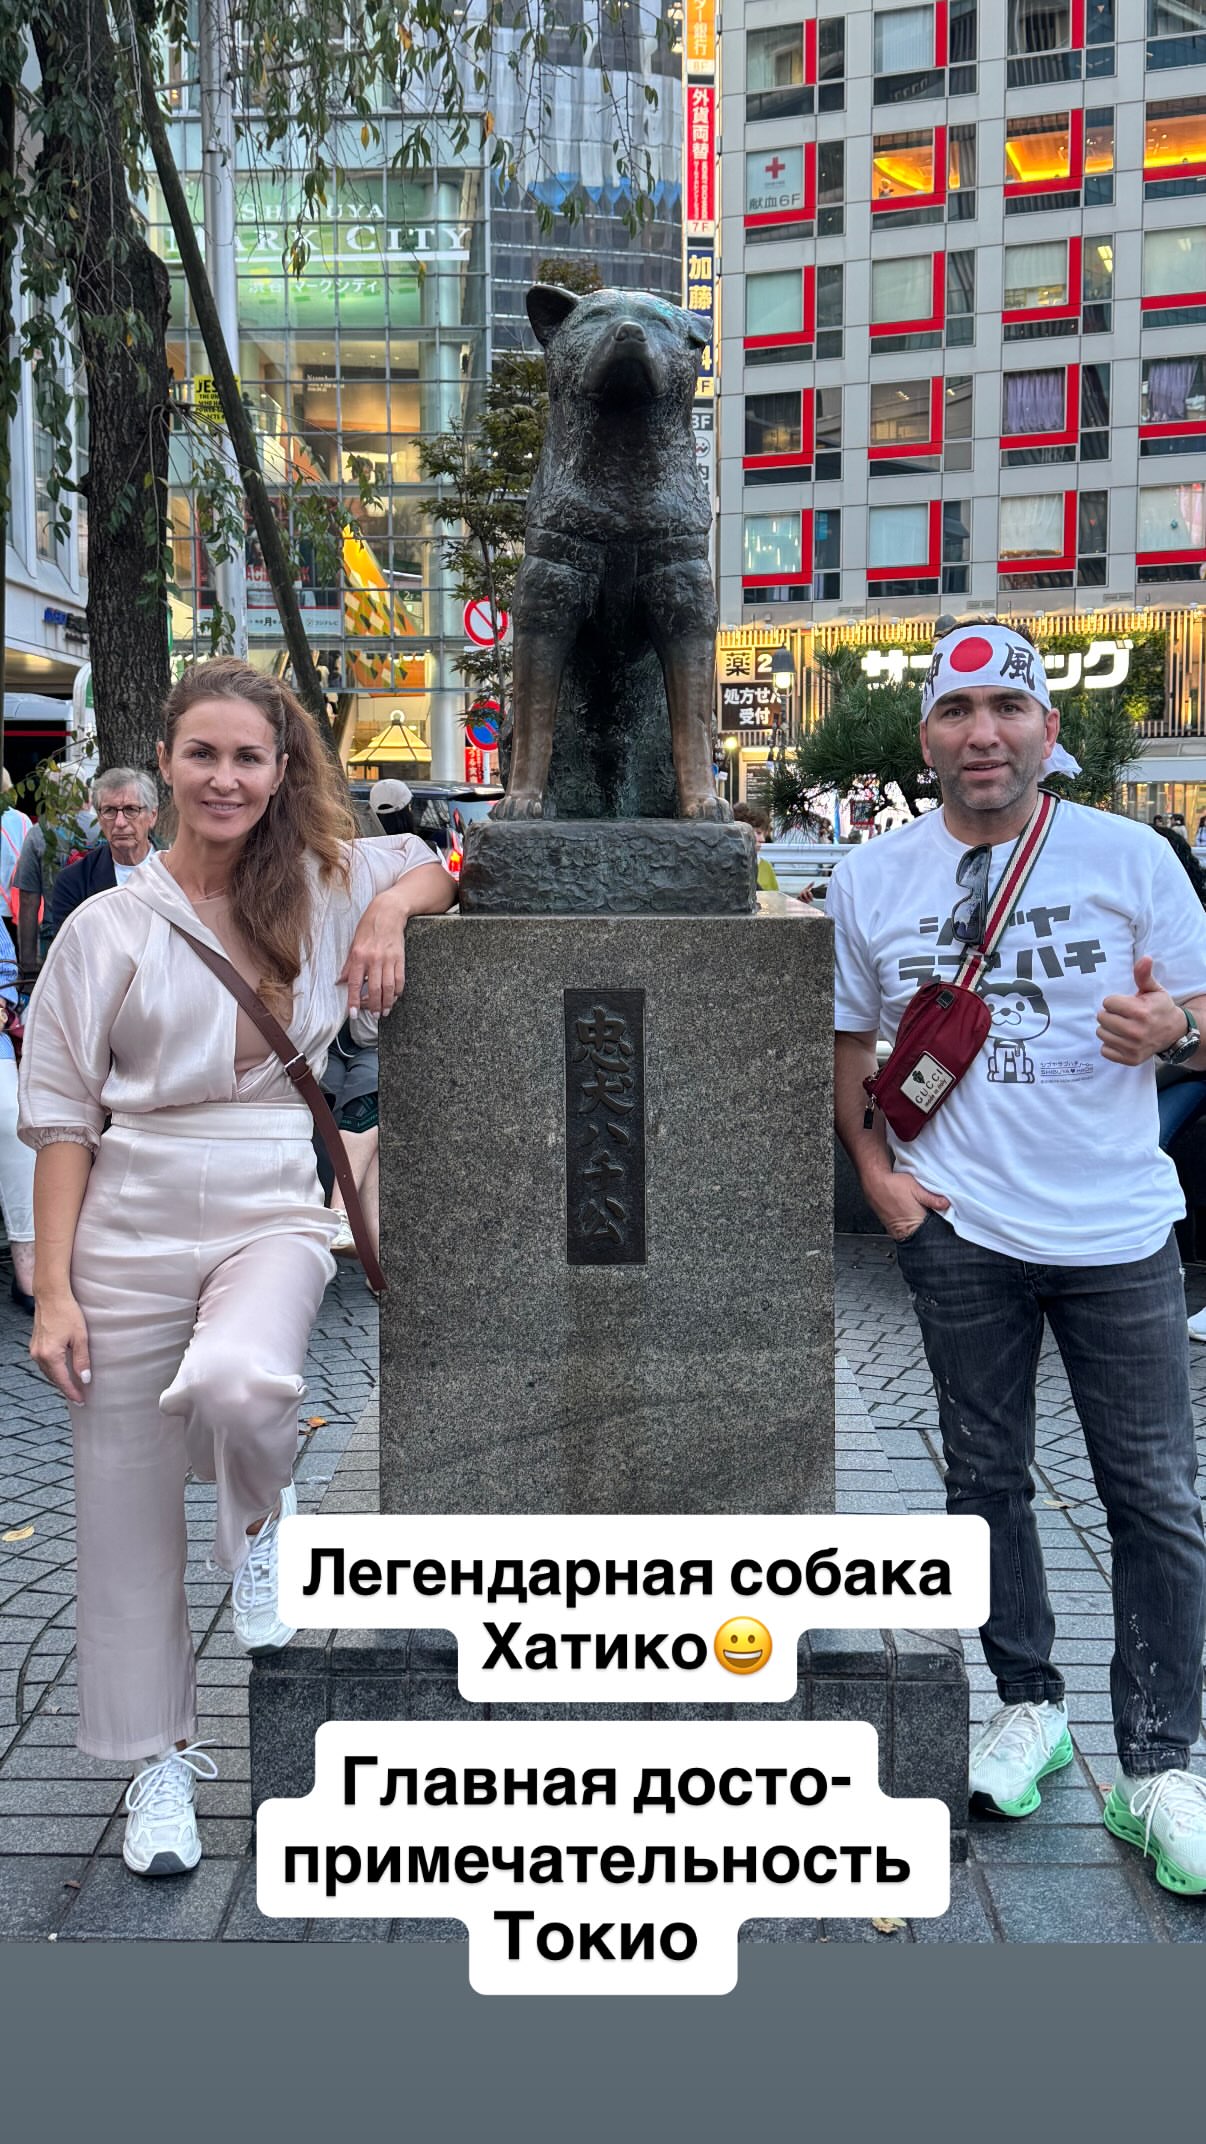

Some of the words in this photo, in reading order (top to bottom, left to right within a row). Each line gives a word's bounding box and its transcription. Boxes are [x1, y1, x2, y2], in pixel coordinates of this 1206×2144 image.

[692, 87, 709, 160] 外貨両替
[749, 193, 801, 210] 献血6F
[347, 226, 470, 250] CITY
[692, 222, 709, 233] 7F
[726, 651, 750, 677] 薬
[739, 707, 771, 725] 受付
[915, 1068, 943, 1104] GUCCI
